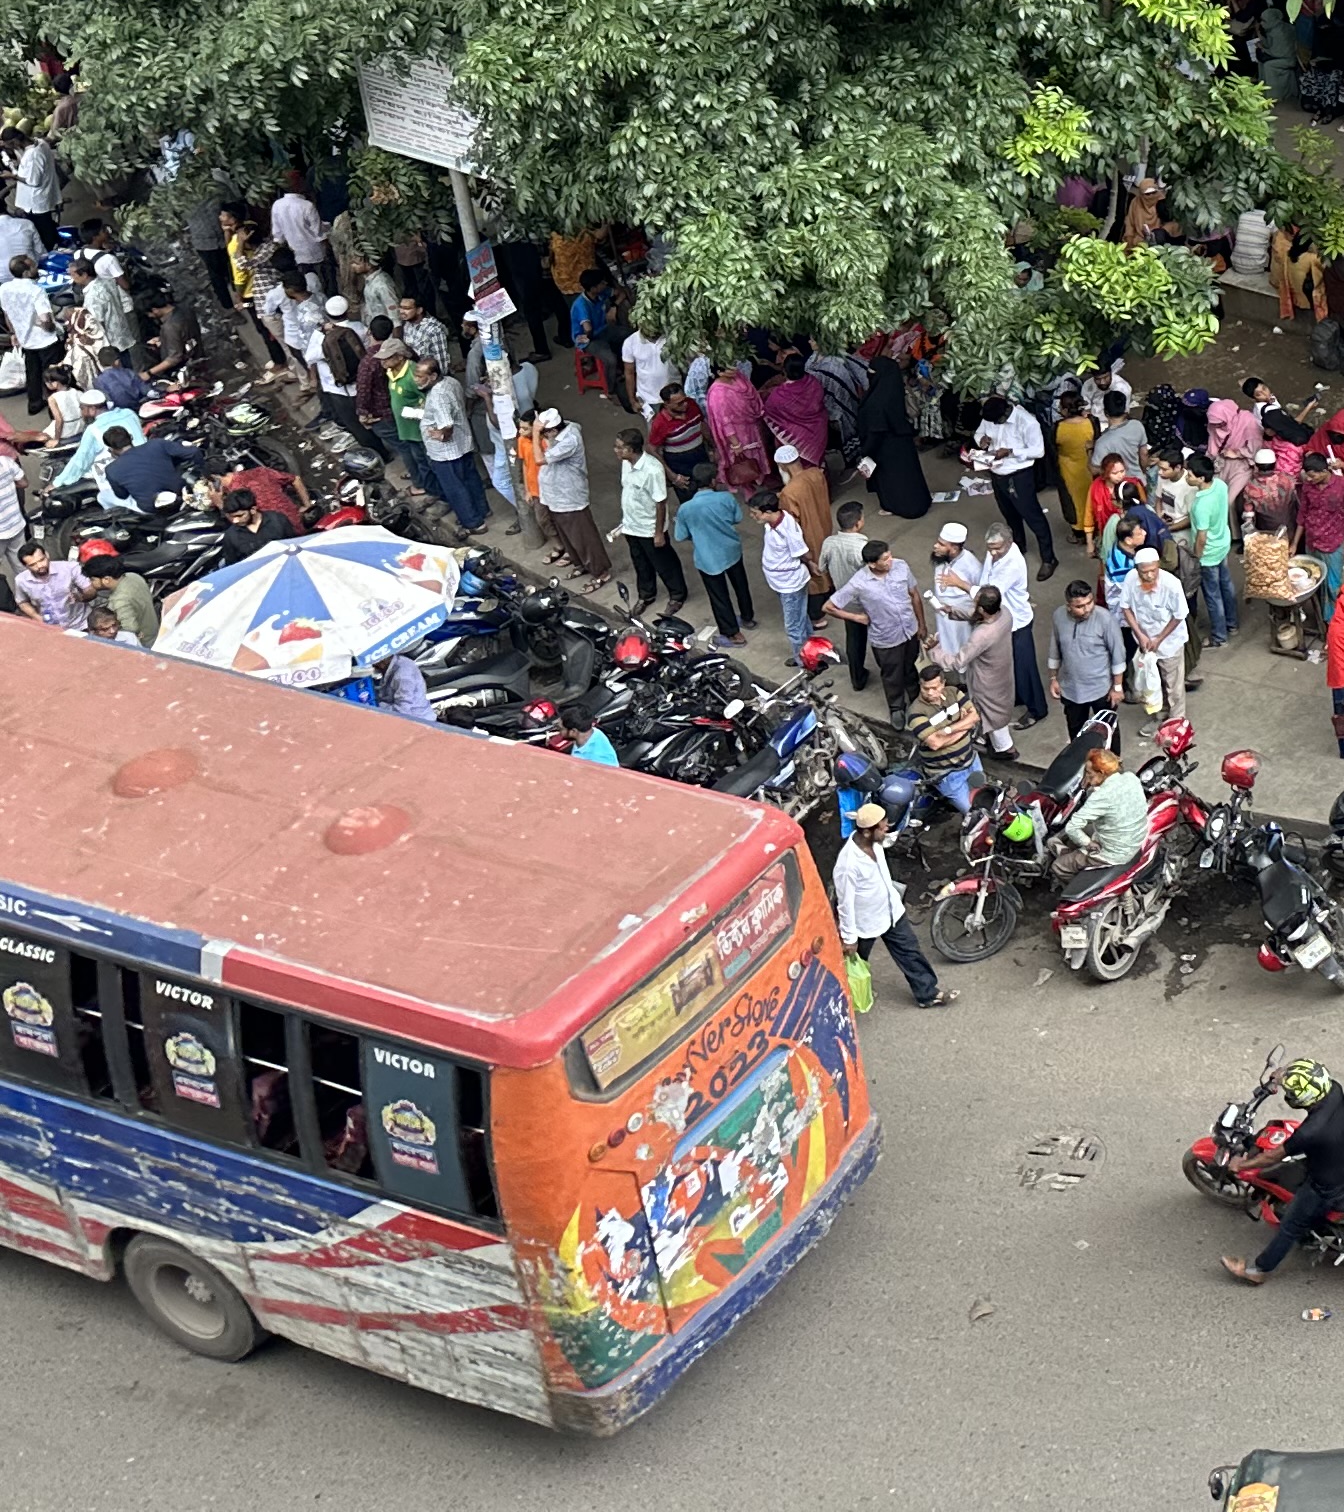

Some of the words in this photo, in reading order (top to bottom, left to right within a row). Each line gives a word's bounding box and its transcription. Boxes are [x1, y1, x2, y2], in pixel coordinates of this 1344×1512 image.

[361, 601, 404, 629] IGLOO
[177, 641, 214, 660] IGLOO
[365, 644, 391, 664] ICE
[391, 613, 442, 649] CREAM
[748, 882, 784, 934] ক্লাসিক
[0, 937, 56, 964] CLASSIC
[155, 979, 214, 1010] VICTOR
[373, 1047, 436, 1080] VICTOR
[684, 1029, 769, 1126] 2023
